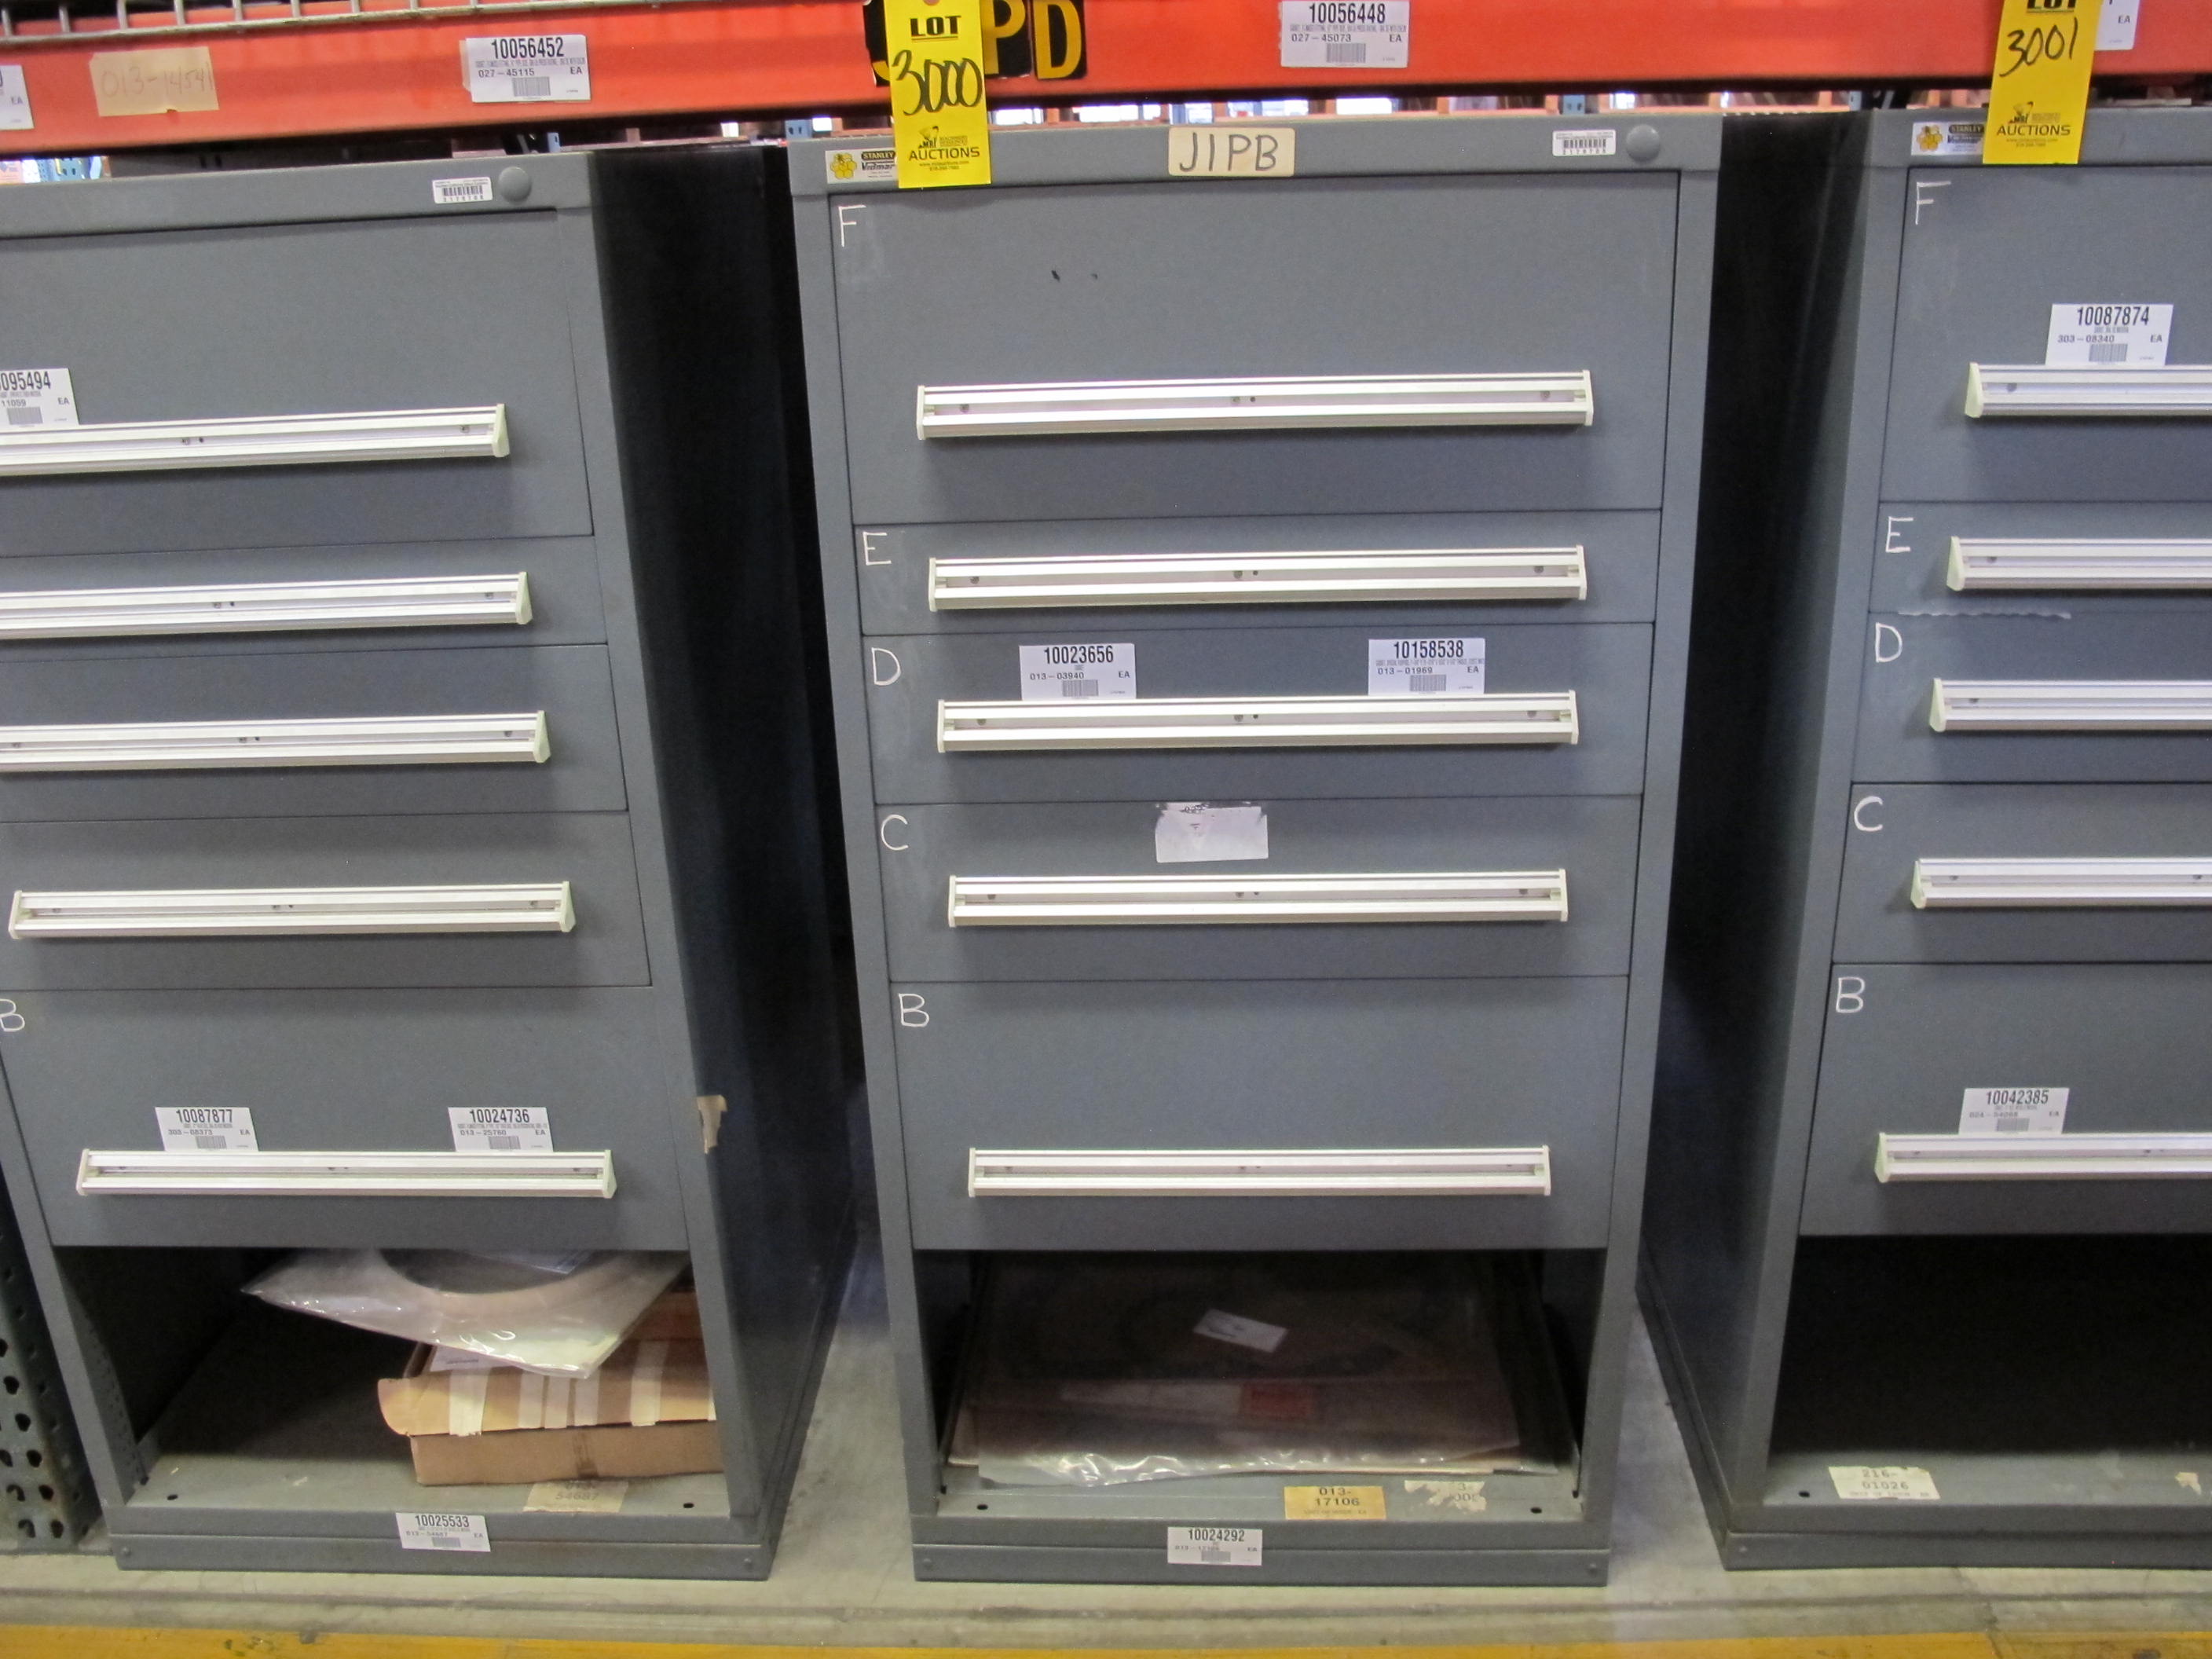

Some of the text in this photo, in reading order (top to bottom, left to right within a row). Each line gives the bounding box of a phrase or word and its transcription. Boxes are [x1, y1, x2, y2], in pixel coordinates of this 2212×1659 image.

[1309, 3, 1386, 24] 10056448
[910, 16, 961, 38] LOT
[492, 37, 565, 59] 10056452
[1999, 17, 2078, 77] 3001
[892, 49, 981, 115] 3000
[1996, 124, 2071, 136] AUCTIONS
[909, 146, 980, 161] AUCTIONS
[1180, 132, 1278, 171] JIPB
[862, 162, 895, 170] Vidmar
[1915, 181, 1951, 225] F
[838, 204, 866, 247] F
[2077, 306, 2150, 325] 10087874
[0, 371, 50, 390] 095494
[1886, 516, 1914, 552] E
[863, 532, 892, 566] E
[1393, 640, 1463, 658] 10158538
[1875, 622, 1903, 662] D
[1044, 646, 1114, 664] 10023656
[871, 647, 901, 686] D
[1854, 797, 1883, 832] C
[881, 815, 909, 851] C
[1836, 976, 1866, 1013] B
[0, 998, 25, 1031] B
[899, 993, 929, 1027] B
[1987, 1090, 2049, 1104] 10042385
[176, 1108, 233, 1122] 10087877
[470, 1108, 529, 1123] 10024736
[1320, 1487, 1351, 1496] 013-
[1862, 1481, 1909, 1490] 01026
[1315, 1497, 1360, 1506] 17106
[415, 1514, 470, 1527] 10025533
[1188, 1529, 1244, 1541] 10024292
